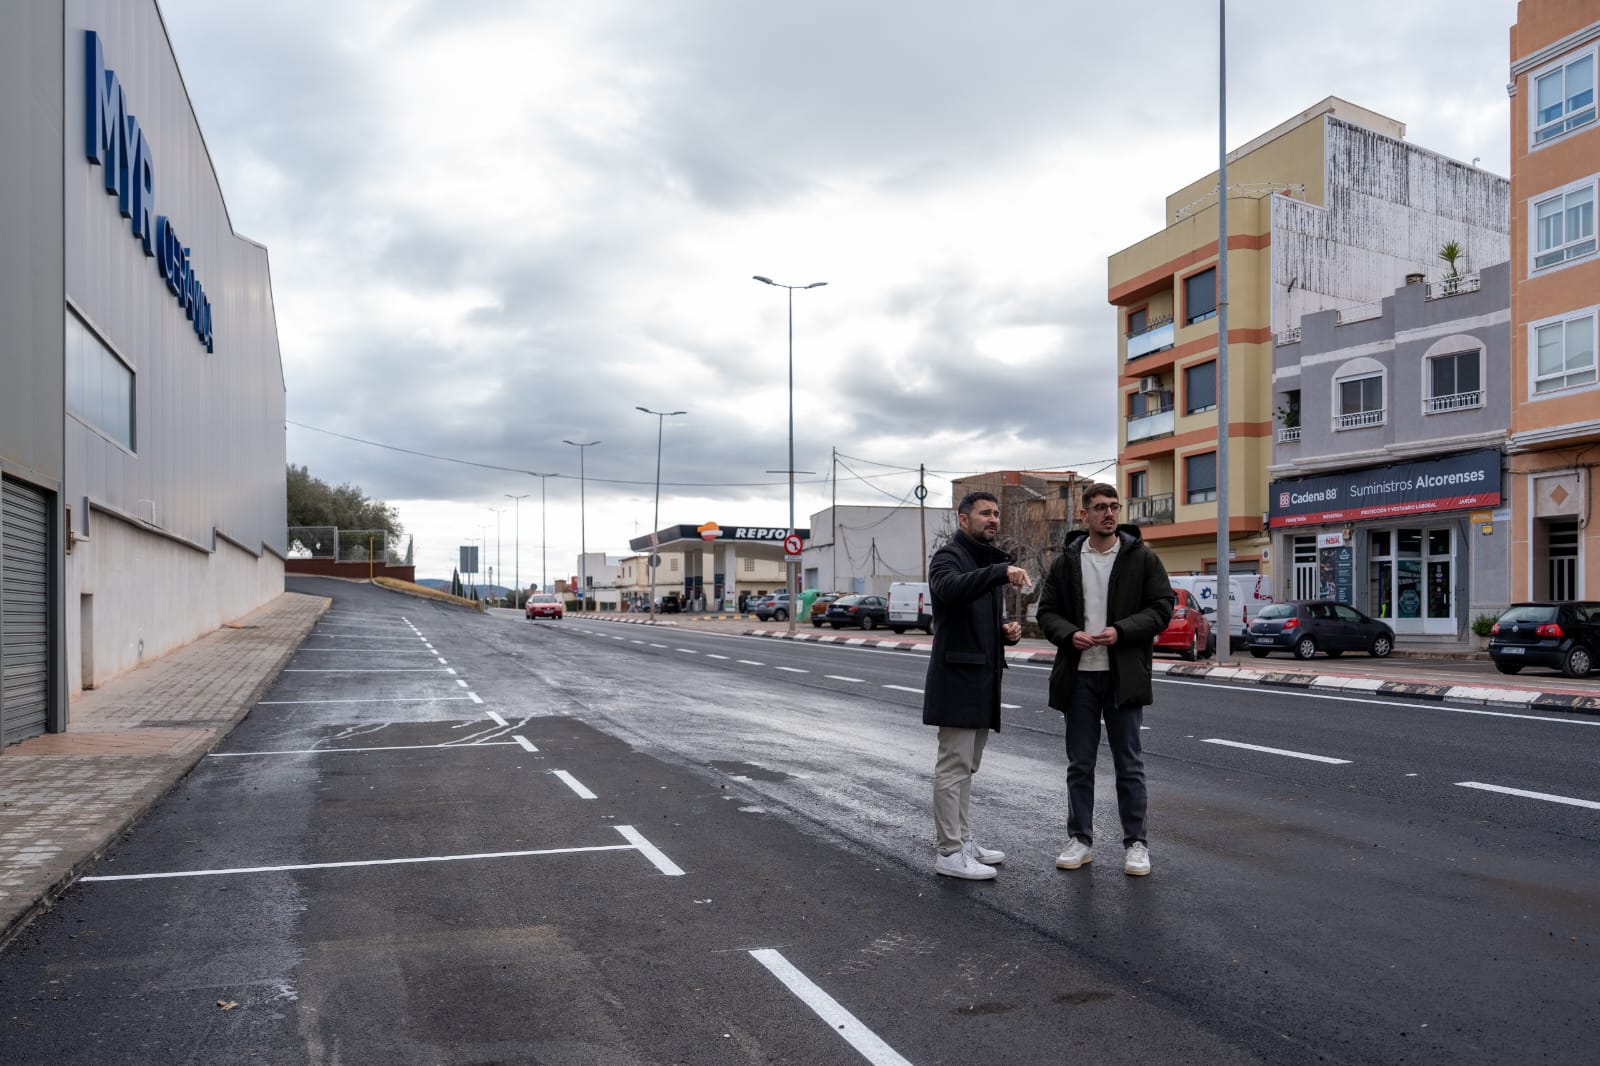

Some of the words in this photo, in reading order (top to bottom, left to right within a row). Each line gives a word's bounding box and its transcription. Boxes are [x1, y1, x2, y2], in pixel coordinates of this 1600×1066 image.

[84, 29, 155, 258] MYR
[1291, 492, 1324, 504] Cadena
[1326, 488, 1336, 500] 88
[1350, 480, 1412, 497] Suministros
[1416, 470, 1484, 488] Alcorenses
